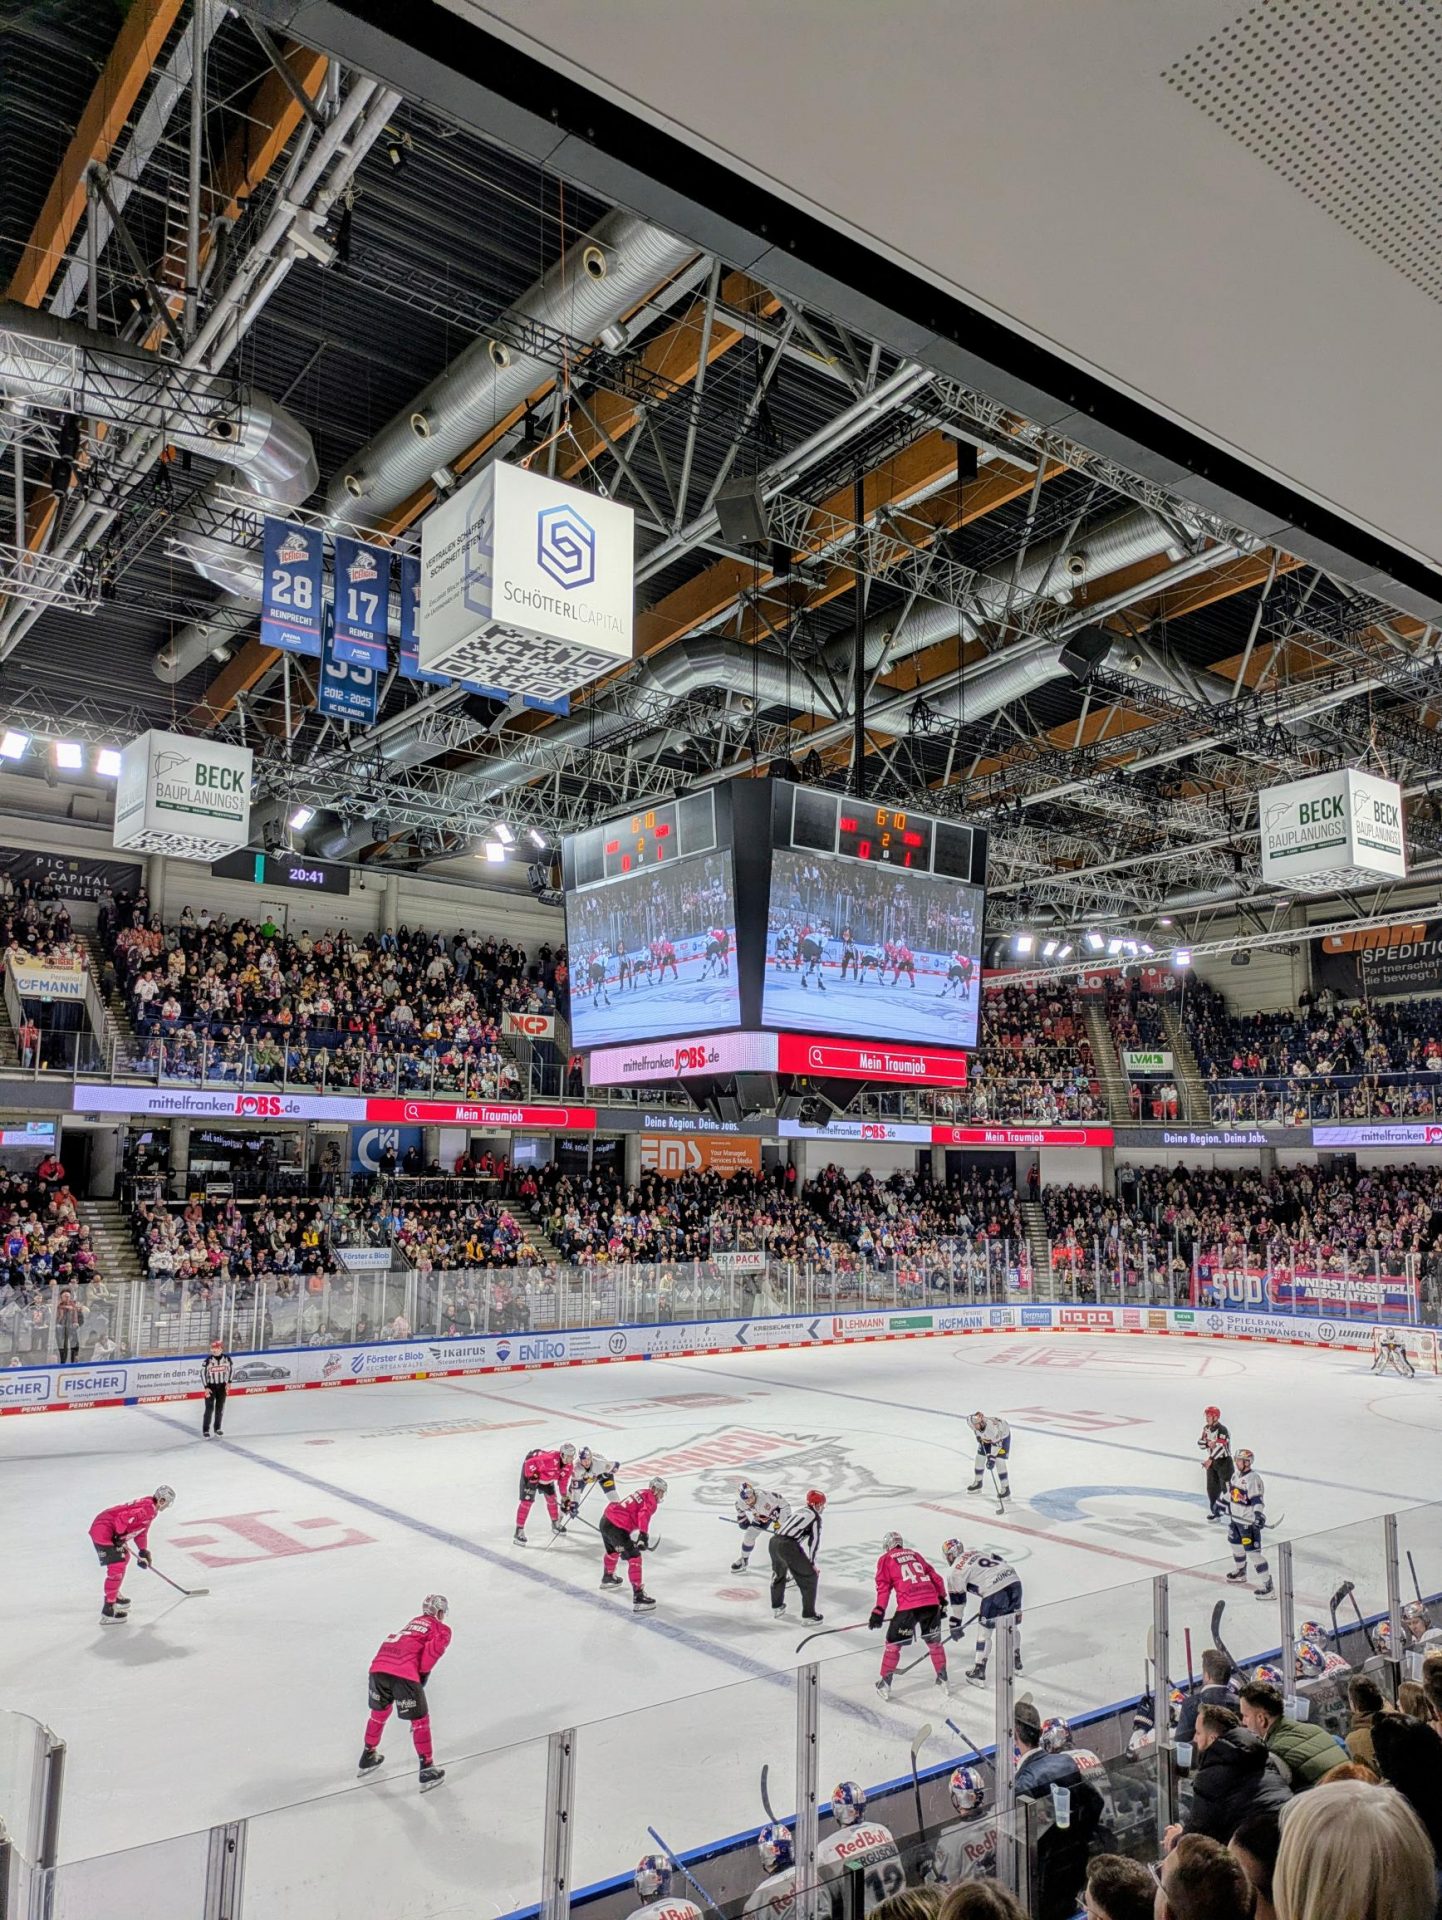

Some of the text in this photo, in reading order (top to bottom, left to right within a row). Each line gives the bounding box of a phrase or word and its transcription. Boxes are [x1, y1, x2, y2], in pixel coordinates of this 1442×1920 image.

[425, 543, 456, 569] VERTRAUEN
[430, 547, 461, 578] SICHERHEIT
[271, 570, 313, 610] 28
[347, 588, 379, 625] 17
[270, 608, 313, 627] REINPRECHT
[349, 626, 374, 641] REIMER
[324, 687, 344, 701] 2012
[350, 693, 372, 707] 2025
[194, 763, 244, 793] BECK
[156, 782, 240, 810] BAUPLANUNGS
[1299, 795, 1344, 825] BECK
[1373, 801, 1399, 828] BECK
[882, 832, 890, 847] 2
[1268, 821, 1342, 849] BAUPLANUNGS
[859, 841, 871, 859] 0
[35, 857, 65, 869] PIC
[622, 855, 631, 872] 0
[48, 871, 110, 887] CAPITAL
[289, 867, 324, 885] 20:41
[622, 1047, 720, 1076] mittelfrankenJOBS.de
[859, 1053, 927, 1077] Mein Traumjob
[1129, 1054, 1153, 1065] LVM
[148, 1095, 301, 1118] mittelfrankenJOBS.de
[455, 1107, 523, 1123] Mein Traumjob
[645, 1115, 670, 1129] Deine
[671, 1117, 696, 1131] Region.
[985, 1132, 1045, 1145] Mein Traumjob
[1163, 1133, 1268, 1146] Deine Region. Deine Jobs.
[722, 1150, 746, 1158] Managed
[1212, 1270, 1262, 1304] SÜD
[1304, 1288, 1386, 1305] ABSCHAFFEN
[844, 1318, 884, 1329] LEHMANN
[1062, 1310, 1112, 1324] hapa
[1227, 1316, 1285, 1328] SPIELBANK
[1227, 1325, 1312, 1338] FEUCHTWANGEN
[367, 1354, 398, 1365] Förster
[405, 1352, 424, 1361] Blob
[438, 1356, 485, 1367] Steuerberatung
[137, 1370, 163, 1380] Immer
[165, 1370, 170, 1378] in
[171, 1369, 187, 1378] den
[65, 1377, 119, 1391] FISCHER
[900, 1562, 931, 1585] 49
